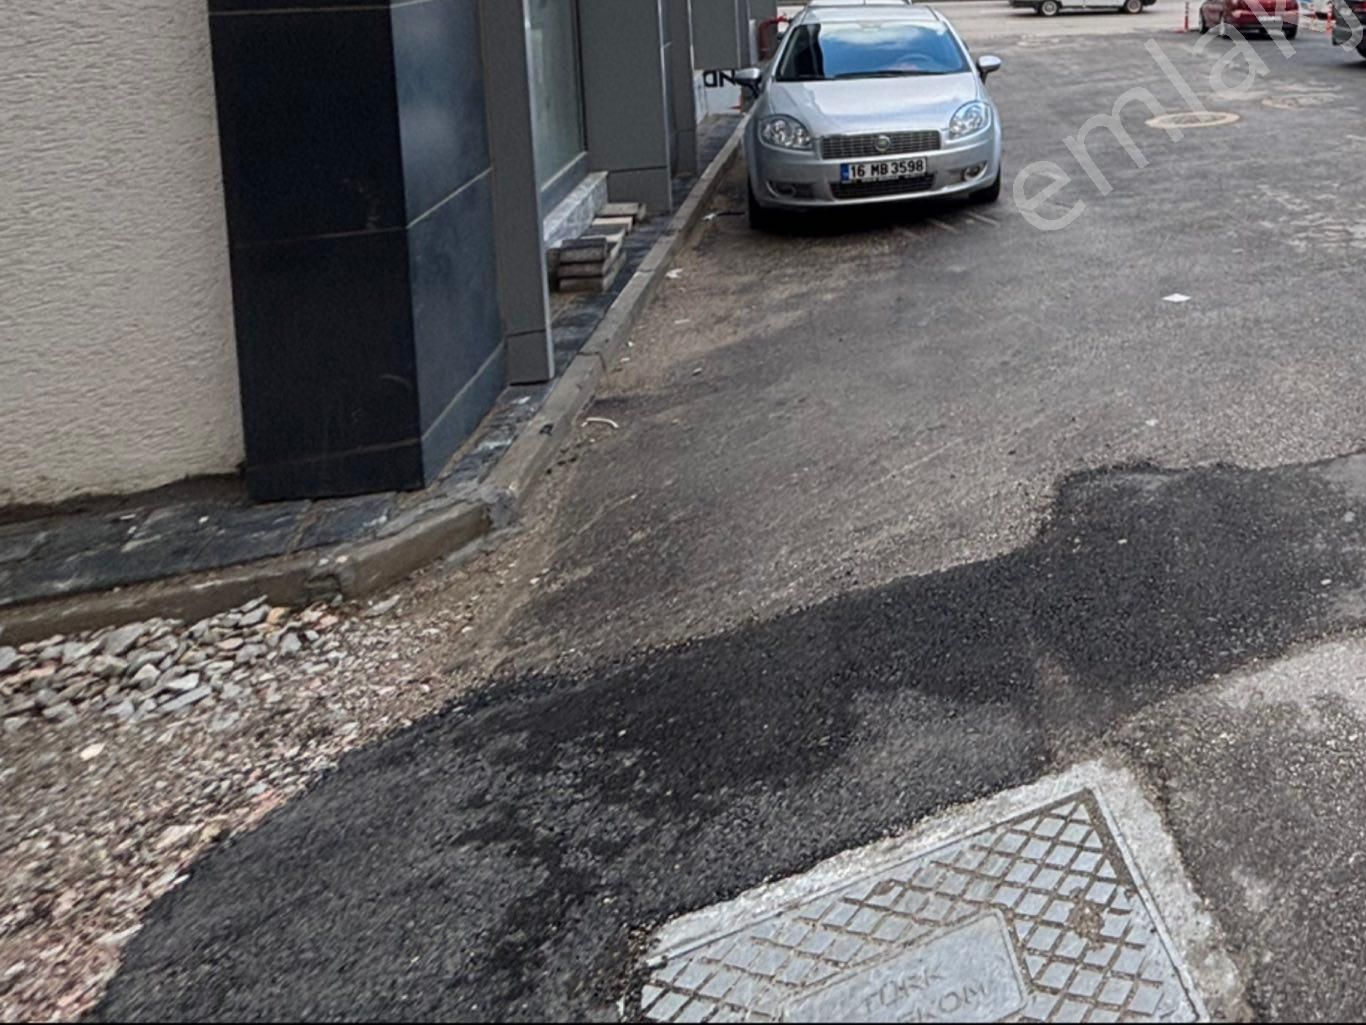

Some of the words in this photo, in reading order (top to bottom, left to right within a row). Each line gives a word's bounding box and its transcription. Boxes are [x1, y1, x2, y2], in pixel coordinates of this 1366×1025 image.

[850, 165, 865, 177] 16
[871, 163, 891, 176] MB
[891, 160, 924, 175] 3598
